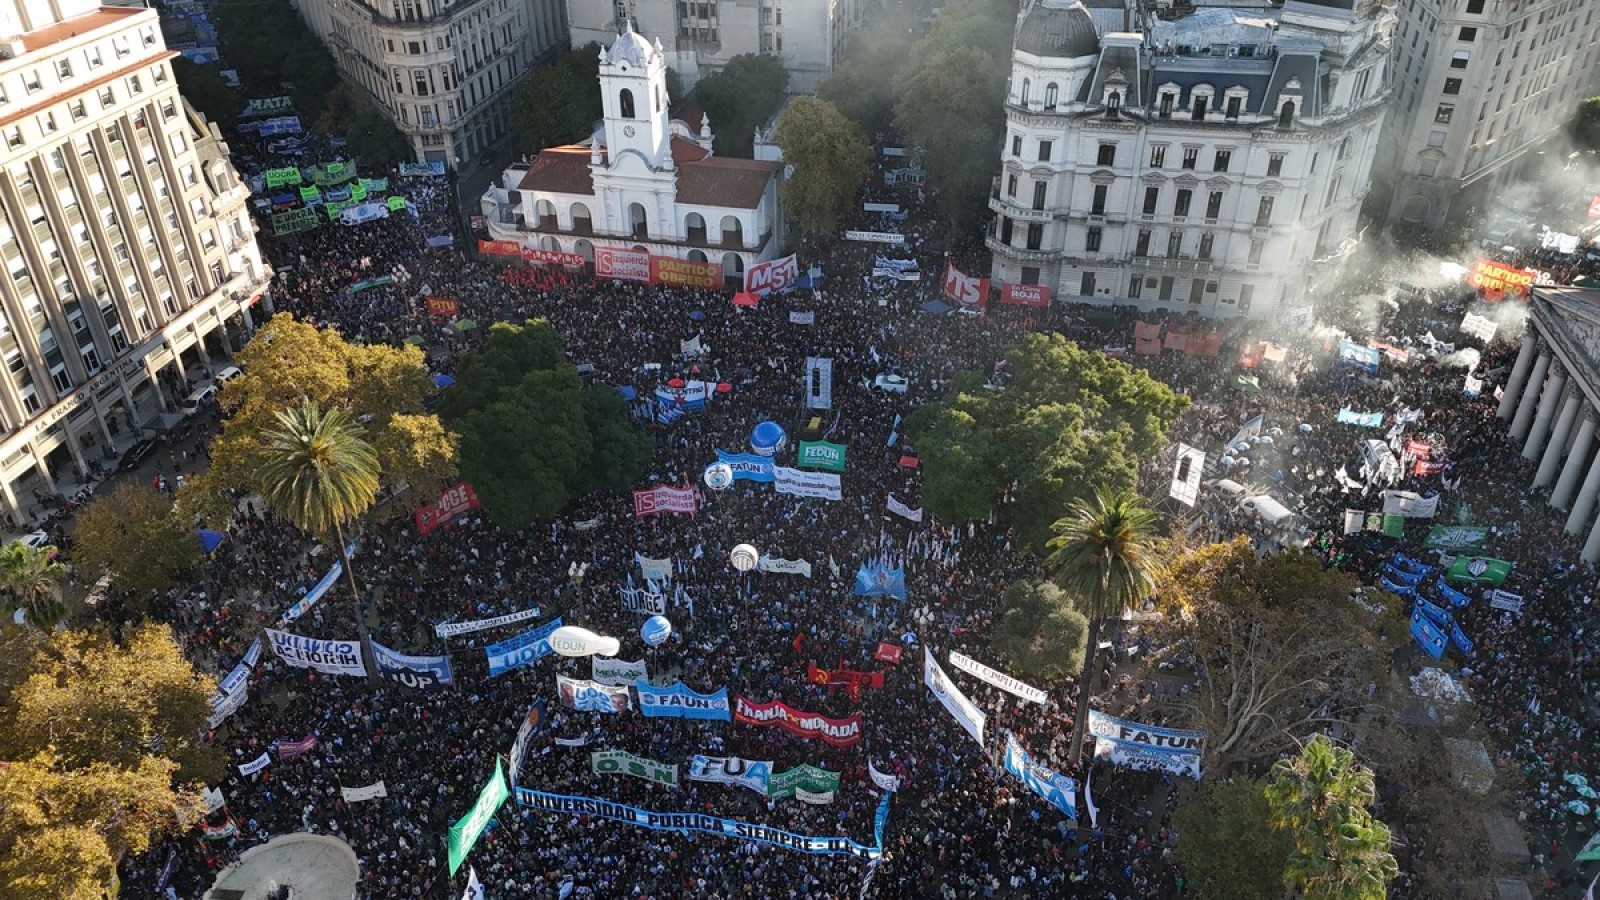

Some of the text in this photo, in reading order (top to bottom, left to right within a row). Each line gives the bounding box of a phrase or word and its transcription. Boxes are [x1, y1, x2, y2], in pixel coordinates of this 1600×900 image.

[659, 259, 717, 276] PARTIDO
[751, 262, 798, 290] MST
[1478, 262, 1531, 285] PARTIDO
[659, 272, 713, 287] OBRERO
[1011, 291, 1040, 300] ROJA
[35, 358, 133, 431] LA FRANCO ARGENTINA
[804, 445, 839, 461] FEDUN
[731, 463, 760, 473] FATUN
[503, 639, 550, 667] UDA
[736, 697, 860, 737] FRANJA MORADA
[1119, 726, 1200, 749] FATUN
[522, 791, 637, 823] UNIVERSIDAD
[647, 813, 725, 833] PUBLICA
[735, 822, 813, 852] SIEMPRE
